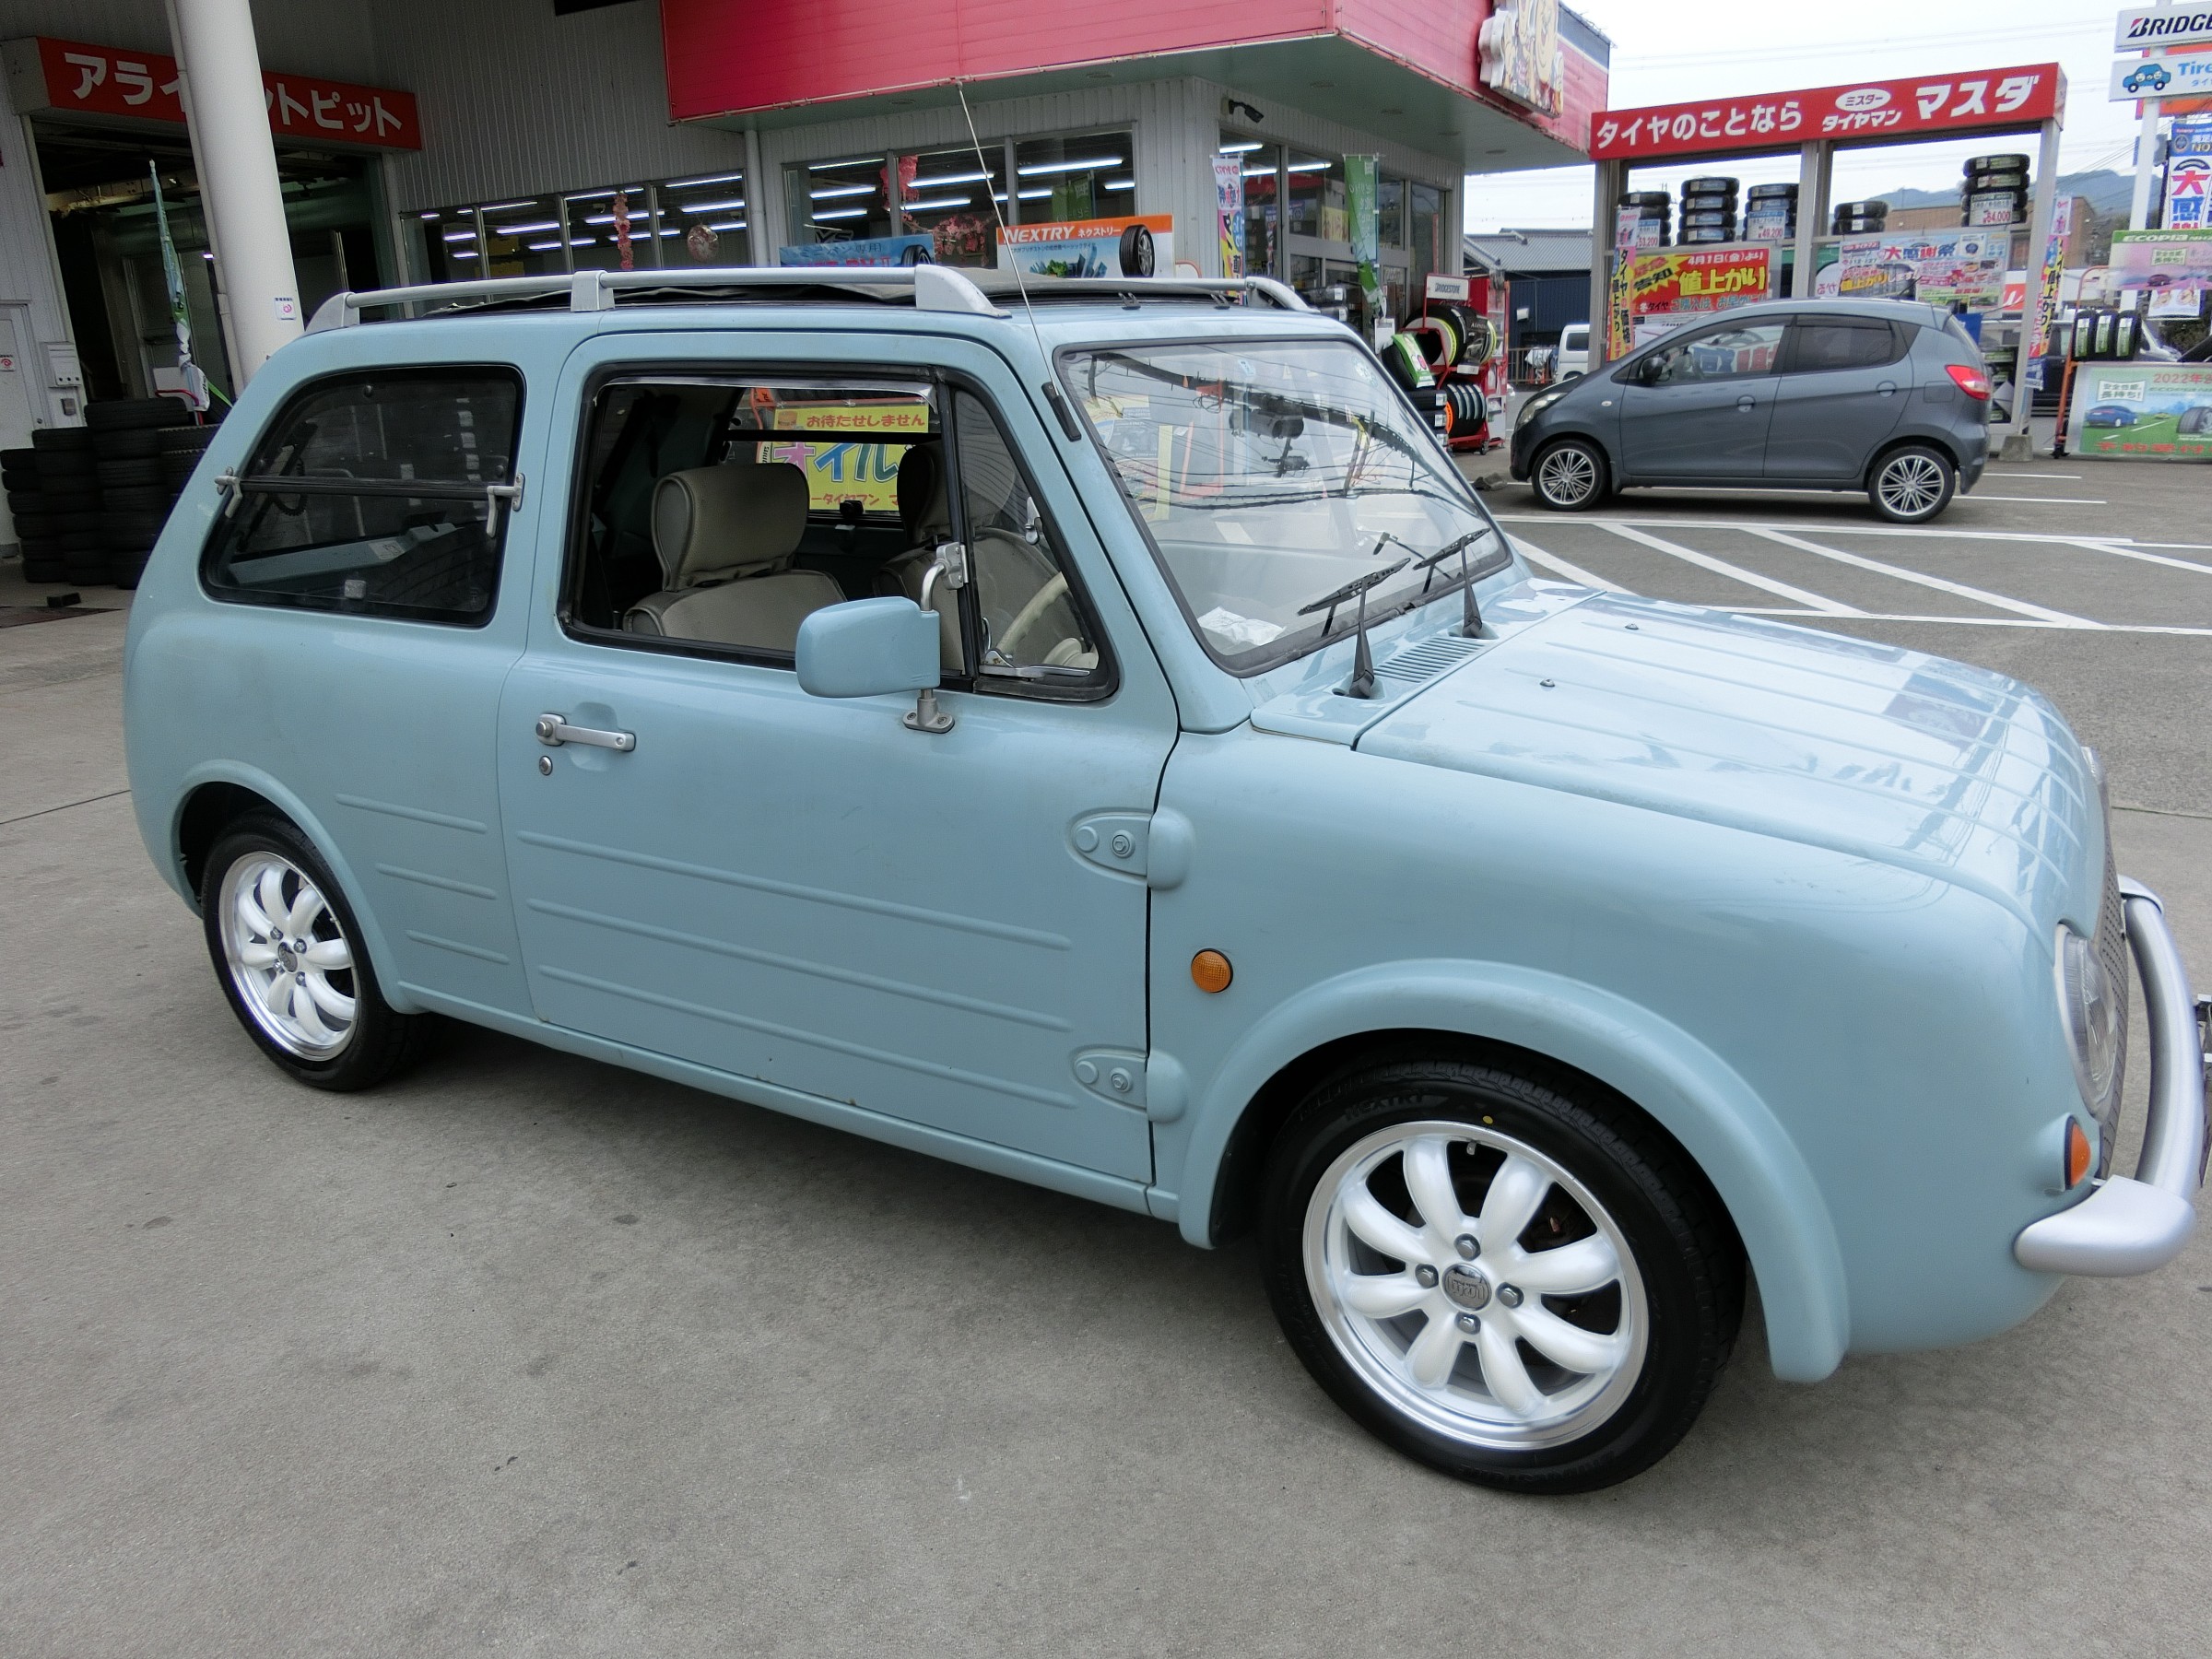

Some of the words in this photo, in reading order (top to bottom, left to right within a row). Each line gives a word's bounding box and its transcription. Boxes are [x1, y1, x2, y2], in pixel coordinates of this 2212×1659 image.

[1845, 94, 1884, 107] ミスター
[1914, 76, 2039, 121] マスダ
[1596, 101, 1803, 149] タイヤのことなら
[1822, 110, 1901, 132] タイヤマン
[1004, 225, 1075, 243] NEXTRY
[1077, 226, 1122, 238] ネクストリー
[1688, 252, 1763, 265] 4月1日(金)より
[1678, 265, 1766, 297] 値上がり
[806, 414, 925, 428] お待たせしません
